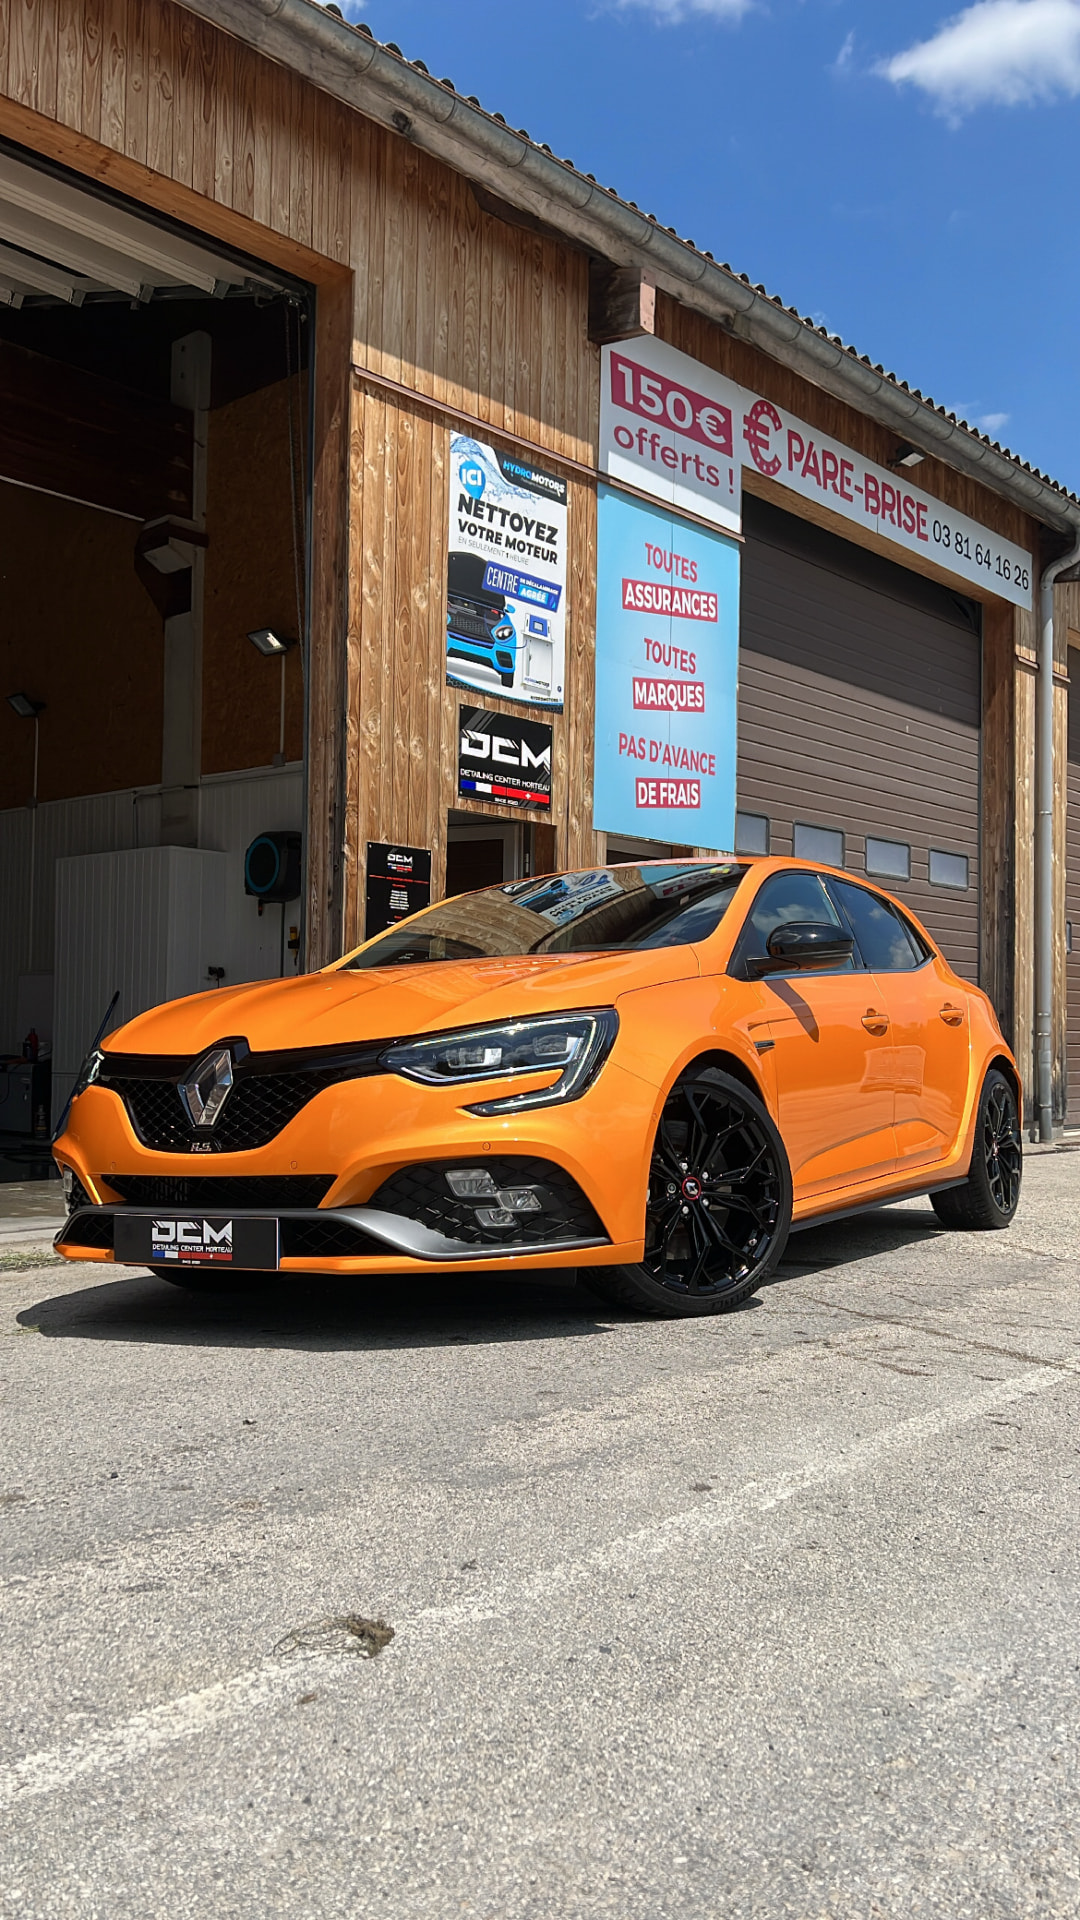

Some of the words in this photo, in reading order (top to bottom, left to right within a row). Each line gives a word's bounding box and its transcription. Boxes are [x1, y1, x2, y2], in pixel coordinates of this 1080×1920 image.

[617, 363, 726, 444] 150€
[614, 425, 720, 487] offerts
[462, 468, 482, 486] ICI
[503, 461, 565, 498] HYDROMOTORS
[457, 493, 559, 546] NETTOYEZ
[787, 429, 929, 542] PARE-BRISE
[933, 520, 950, 548] 03
[955, 532, 972, 560] 81
[975, 543, 991, 570] 64
[995, 555, 1011, 581] 16
[1015, 565, 1029, 590] 26
[458, 518, 503, 546] VOTRE
[505, 535, 558, 565] MOTEUR
[458, 536, 467, 545] EN
[468, 539, 505, 557] SEULEMENT
[486, 566, 519, 594] CENTRE
[644, 542, 698, 583] TOUTES
[624, 582, 716, 619] ASSURANCES
[644, 637, 697, 675] TOUTES
[634, 681, 704, 711] MARQUES
[618, 732, 646, 760] PAS
[460, 768, 494, 782] DETAILING
[494, 775, 521, 787] CENTER
[638, 782, 656, 806] DE
[660, 783, 699, 806] FRAIS
[152, 1243, 179, 1251] DETAILING
